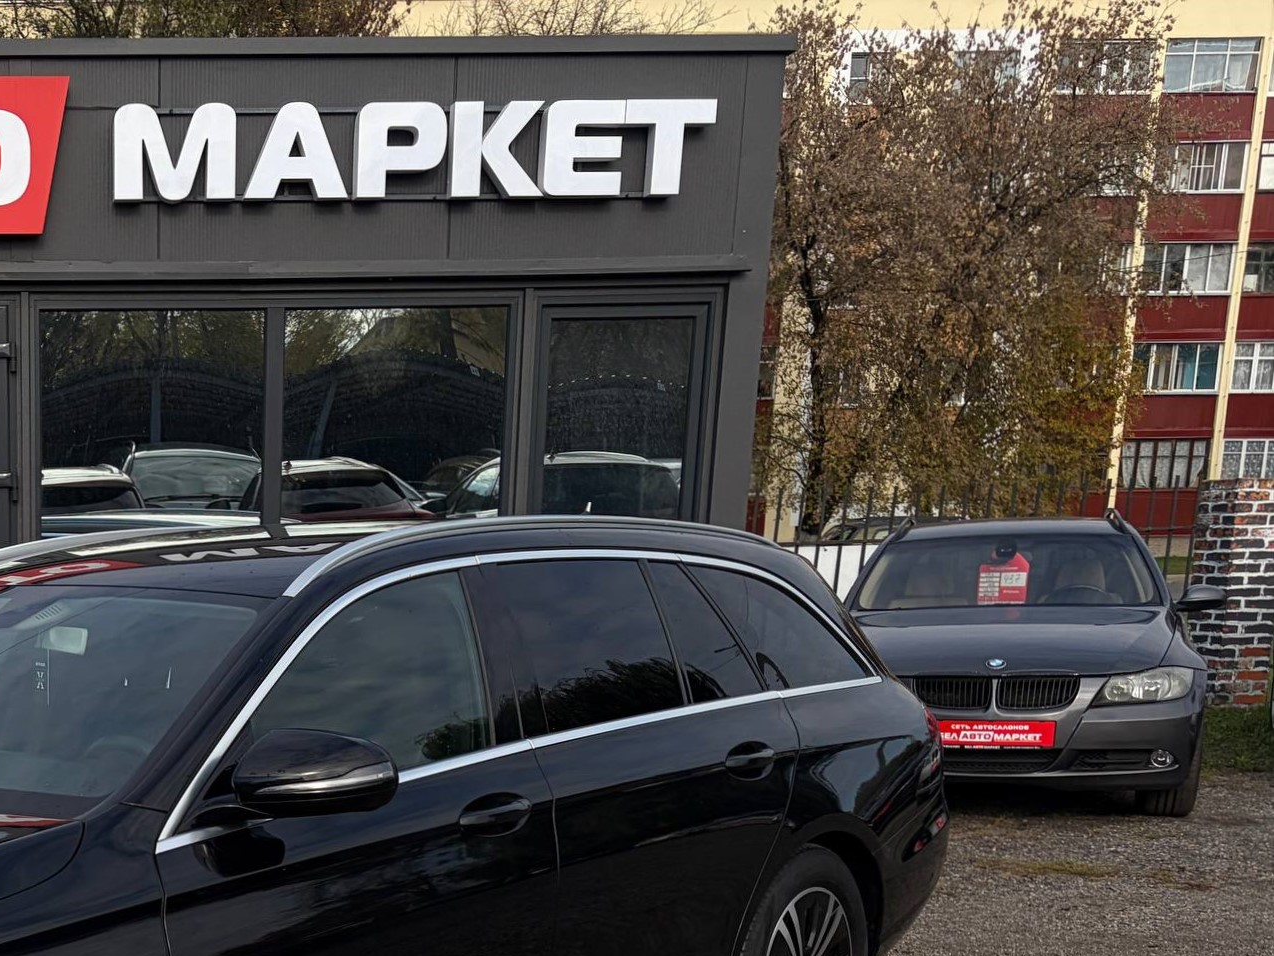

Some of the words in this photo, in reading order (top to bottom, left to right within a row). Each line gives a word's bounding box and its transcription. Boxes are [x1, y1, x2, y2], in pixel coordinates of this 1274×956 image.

[112, 98, 718, 201] МАРКЕТ
[960, 731, 993, 741] АВТО
[993, 732, 1042, 741] МАРКЕТ
